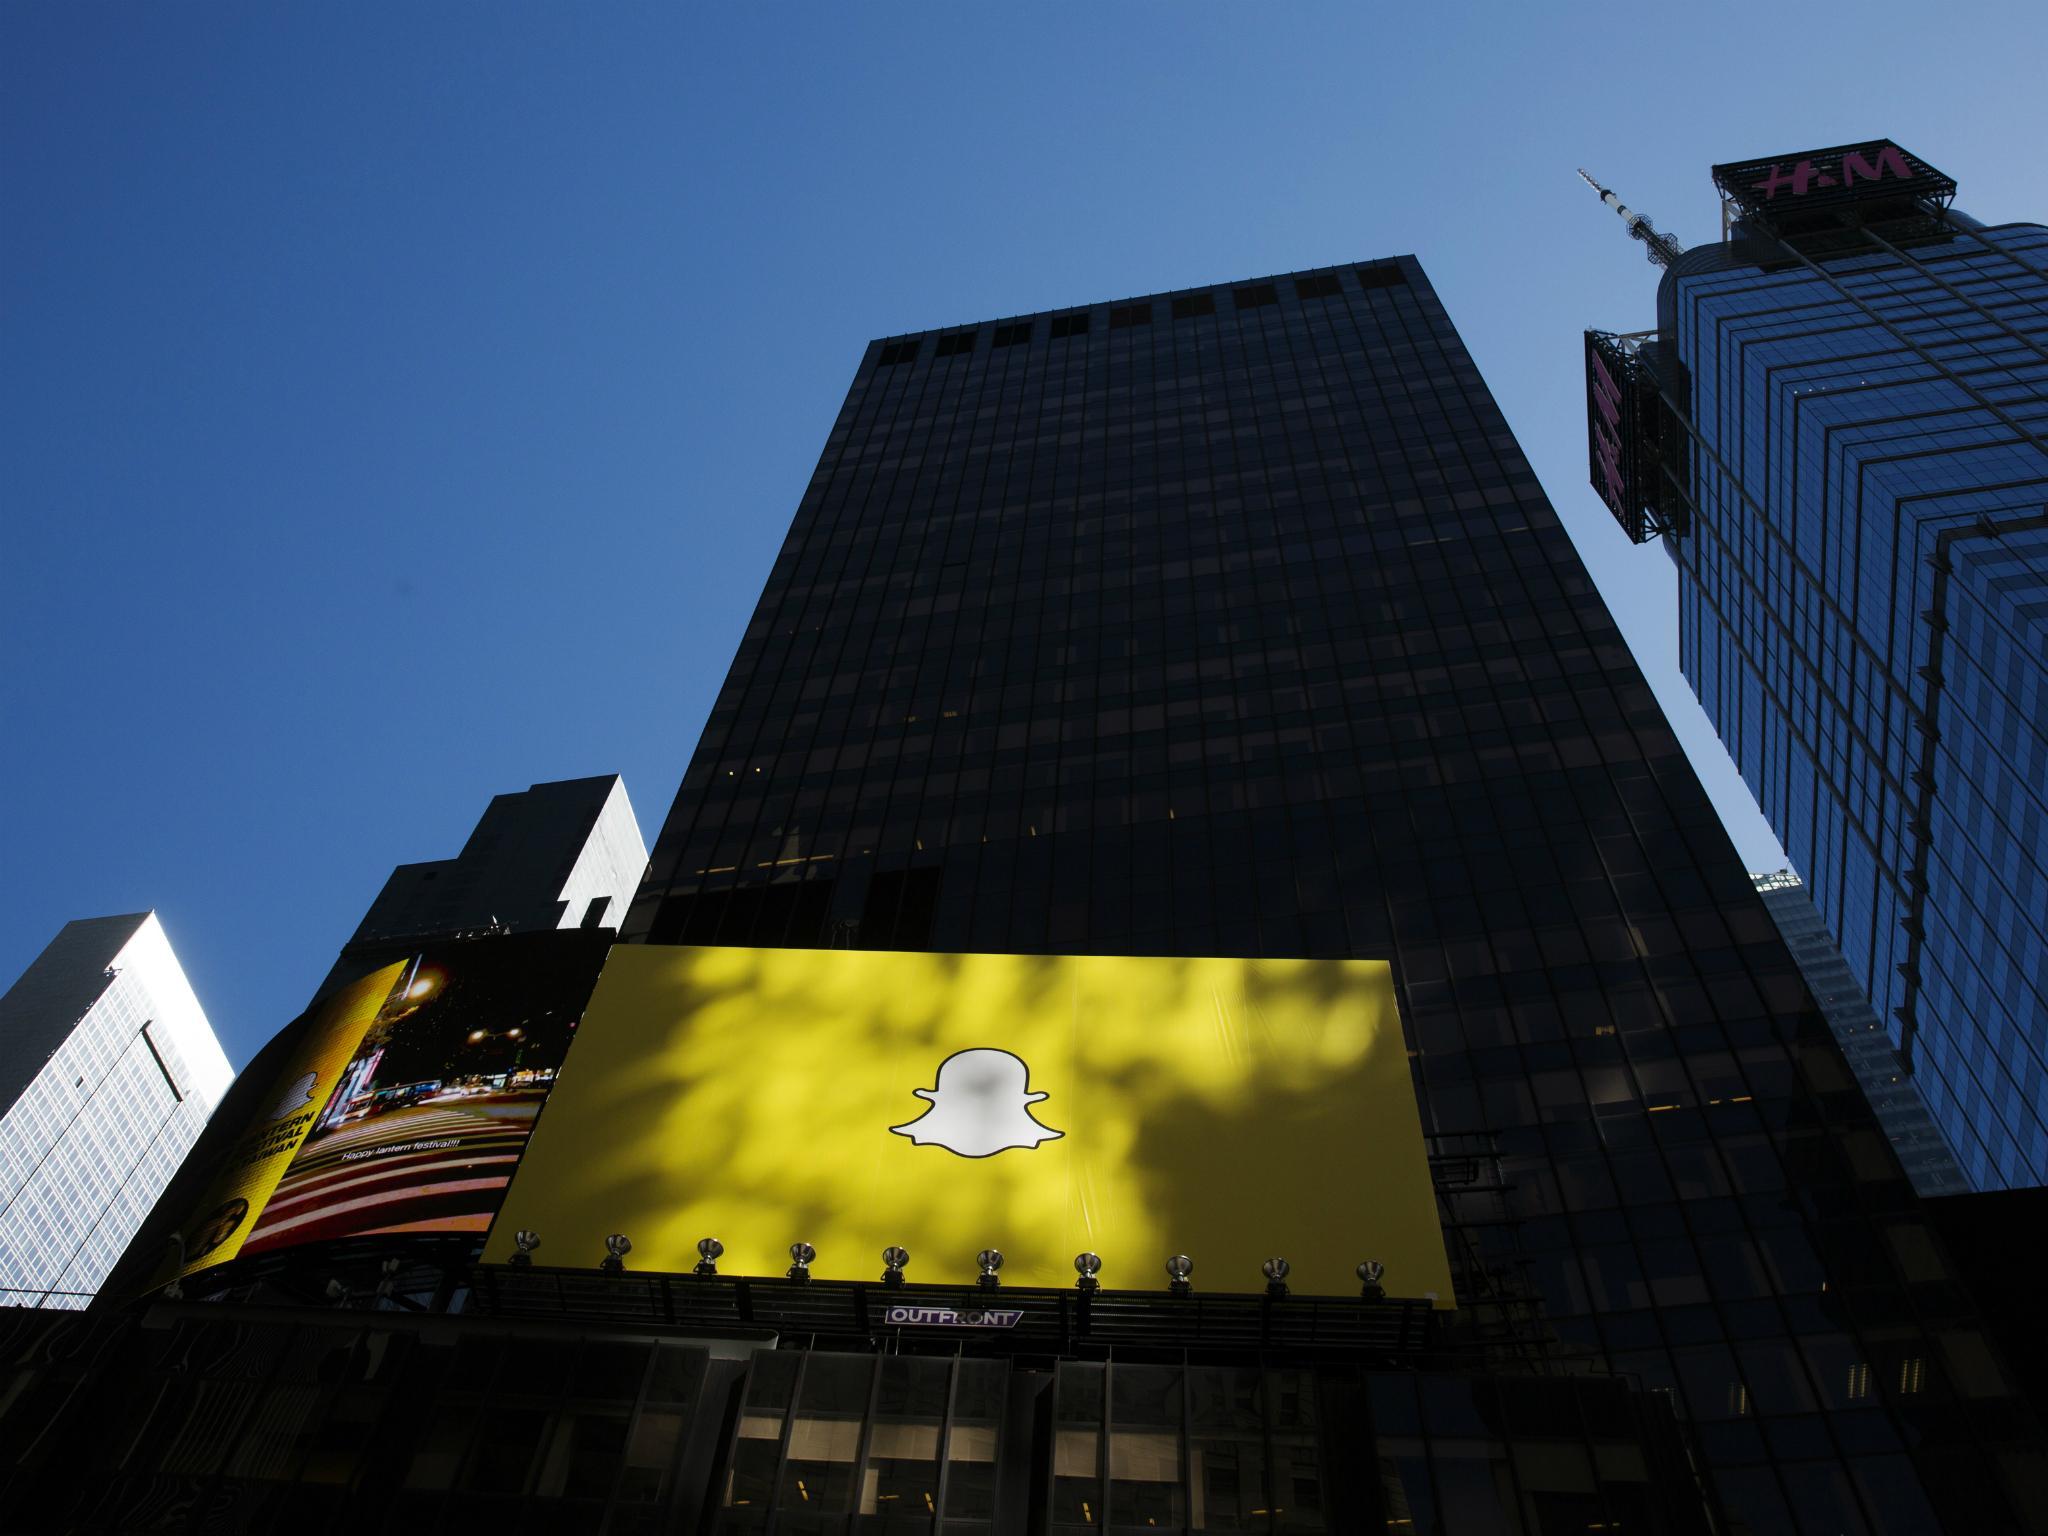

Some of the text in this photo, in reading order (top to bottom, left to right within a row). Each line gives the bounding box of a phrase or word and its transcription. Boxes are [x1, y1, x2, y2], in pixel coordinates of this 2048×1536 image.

[1752, 147, 1914, 200] H&M
[341, 1139, 461, 1161] Happy lantern festival!!!
[890, 1308, 1016, 1326] OUTFRONT
